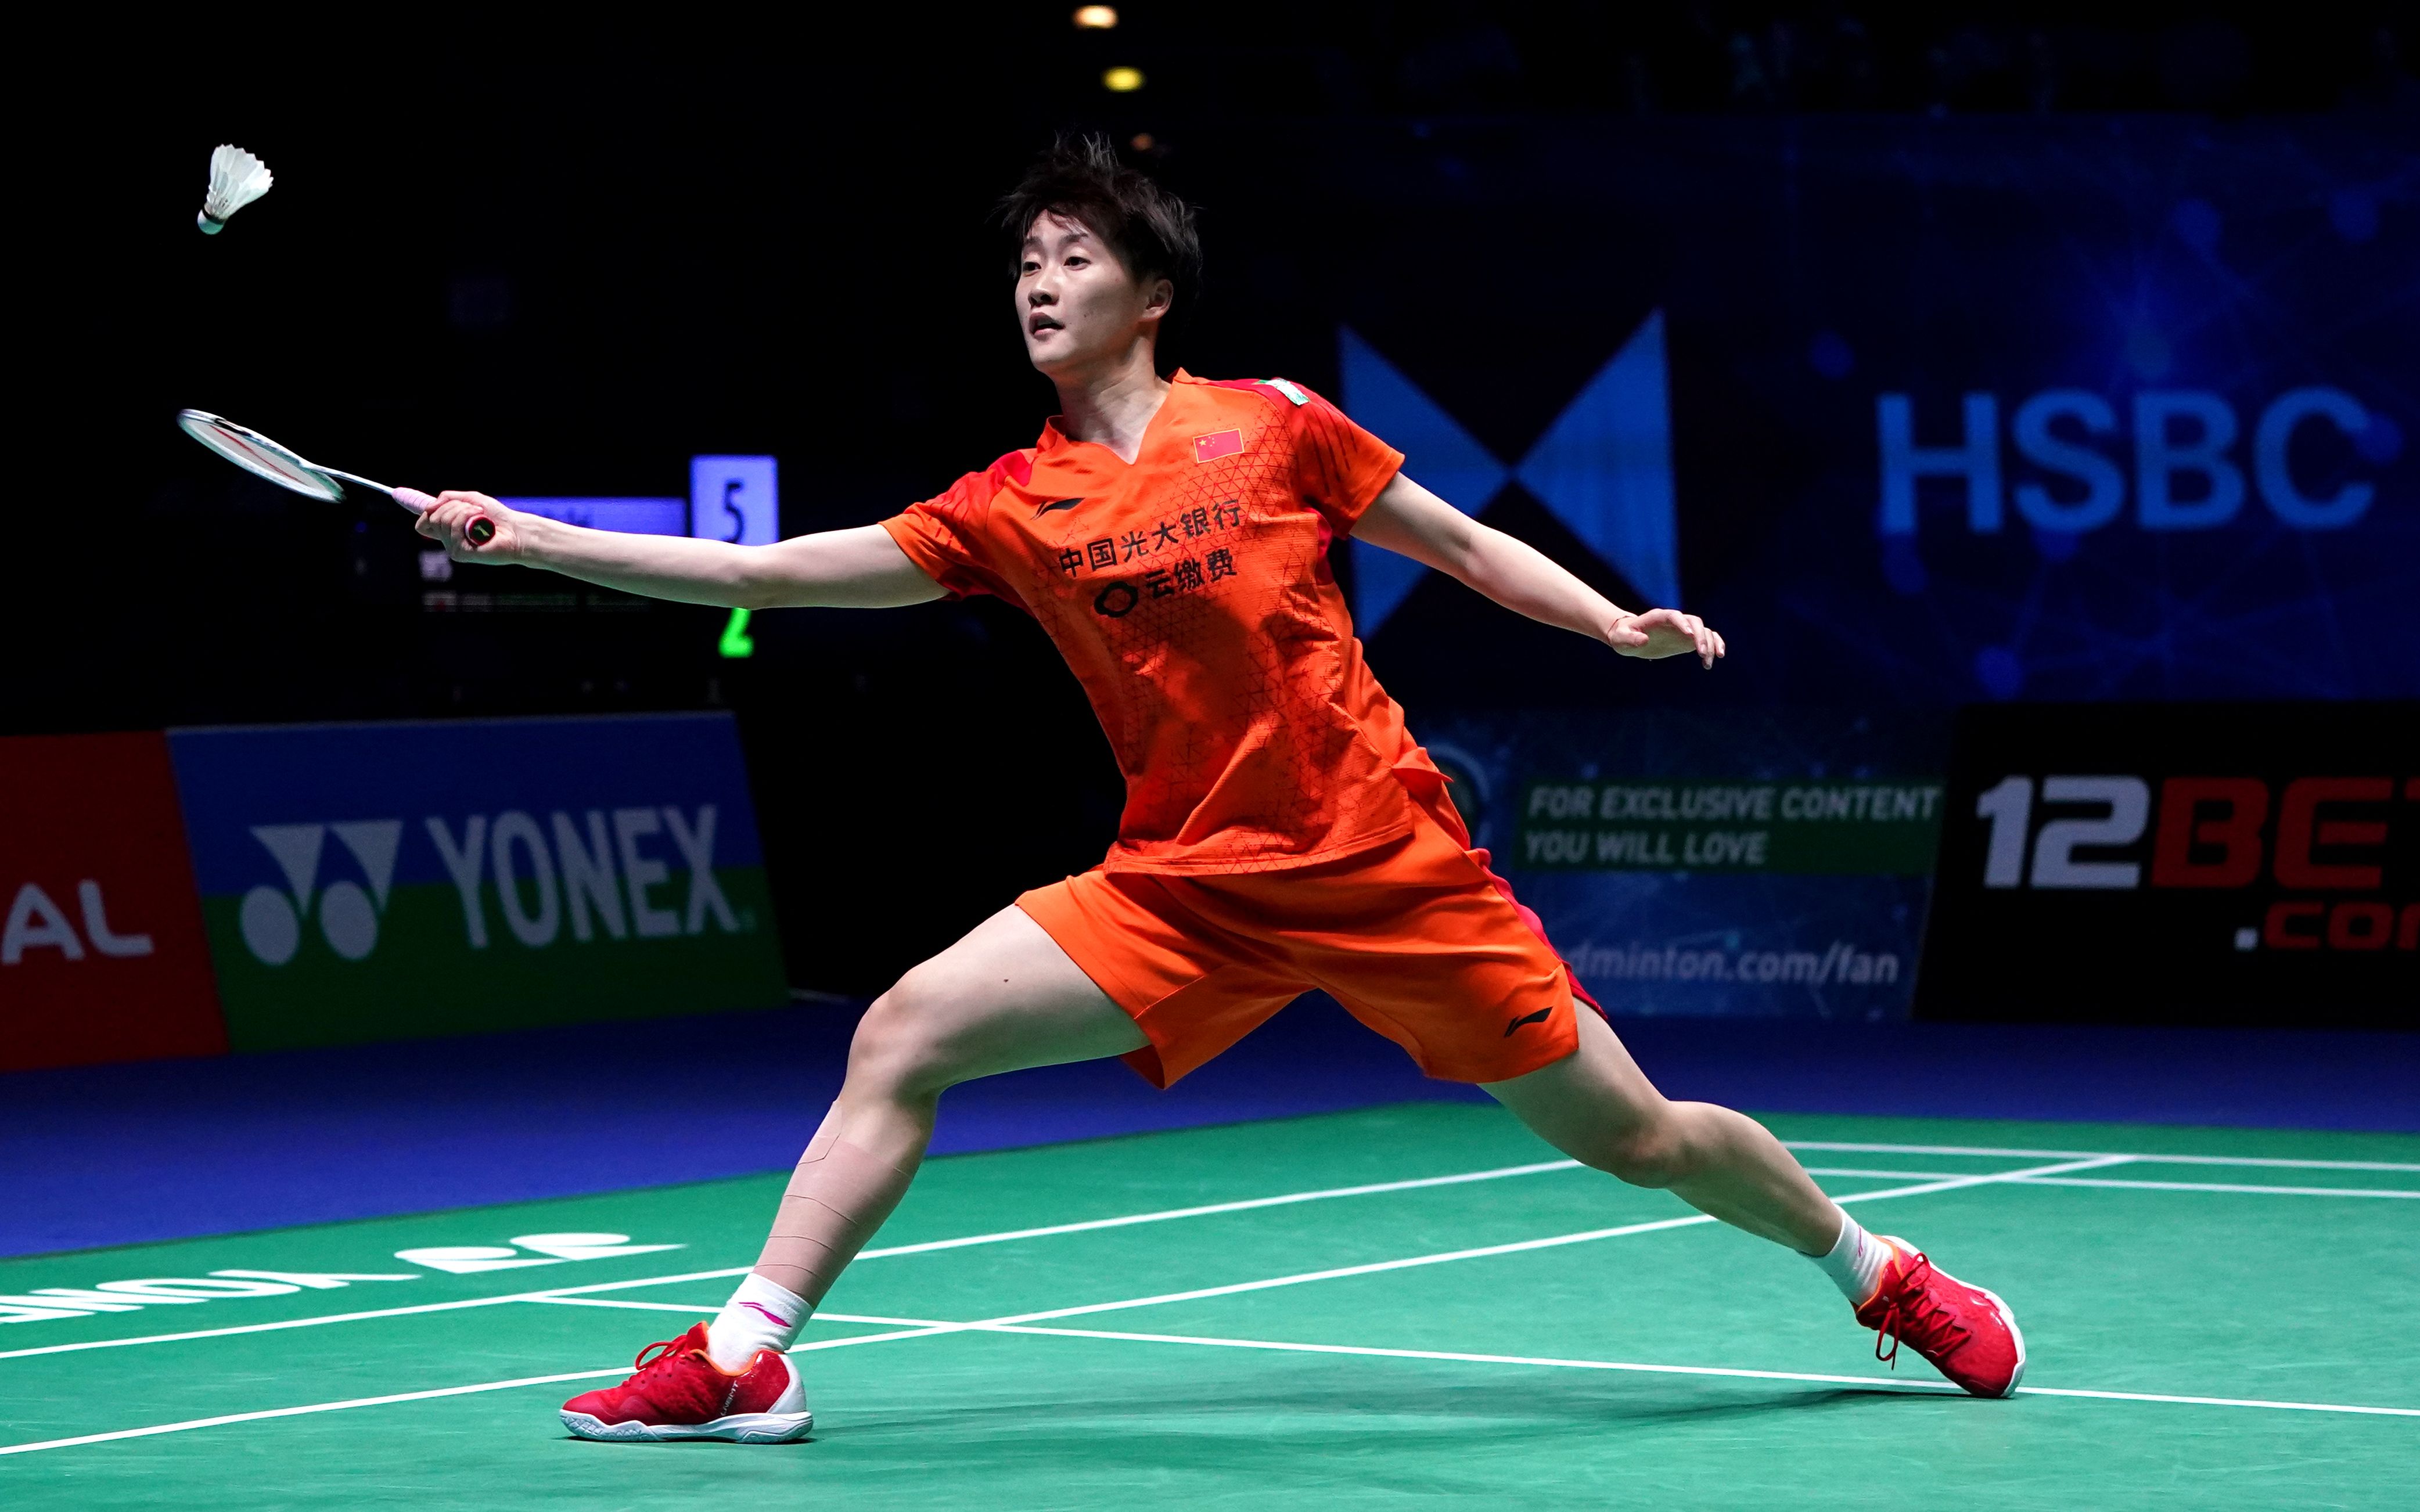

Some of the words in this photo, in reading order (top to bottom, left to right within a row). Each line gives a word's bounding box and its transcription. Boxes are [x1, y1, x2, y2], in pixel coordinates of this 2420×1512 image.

[1877, 386, 2375, 534] HSBC
[722, 479, 745, 544] 5
[1059, 498, 1242, 578] 中国光大银行
[1145, 547, 1238, 600] 云缴费
[1527, 786, 1598, 820] FOR
[1600, 786, 1776, 820] EXCLUSIVE
[1781, 786, 1941, 821] CONTENT
[424, 806, 740, 949] YONEX
[1524, 830, 1590, 864] YOU
[1595, 830, 1677, 865] WILL
[1684, 830, 1770, 866] LOVE
[0, 879, 154, 964] AL
[1562, 938, 1899, 986] dminton.com/fan
